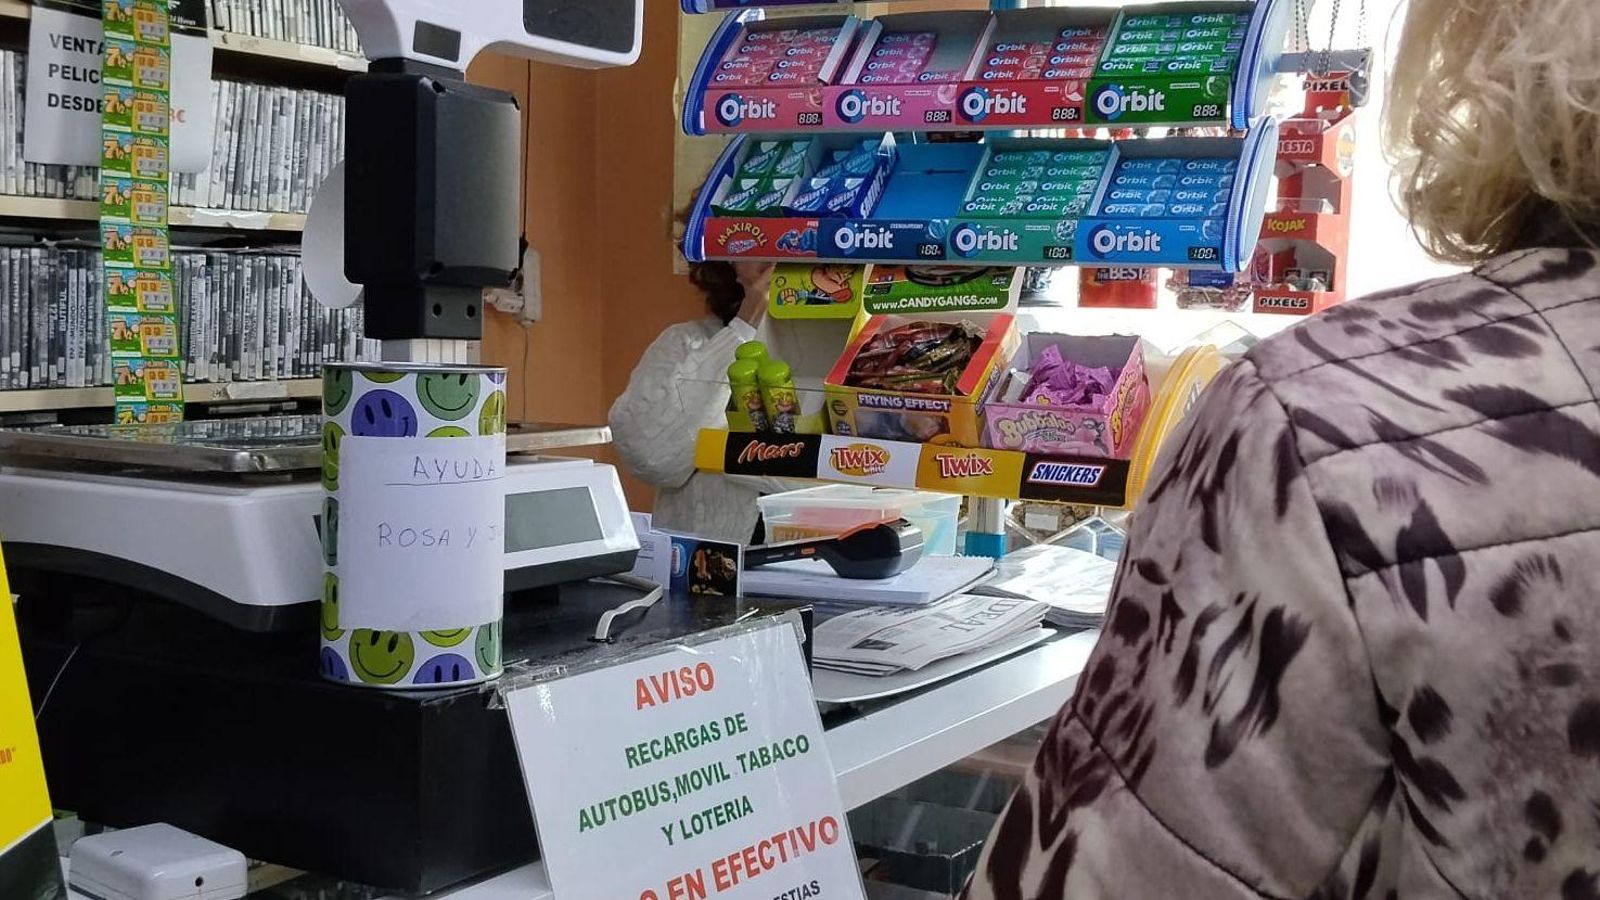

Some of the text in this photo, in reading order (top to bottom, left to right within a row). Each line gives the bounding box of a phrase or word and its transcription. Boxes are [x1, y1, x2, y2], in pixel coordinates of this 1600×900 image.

[1127, 18, 1158, 28] Orbit
[1192, 15, 1224, 24] Orbit
[1062, 28, 1092, 38] Orbit
[1121, 31, 1153, 41] Orbit
[1186, 28, 1219, 38] Orbit
[787, 47, 815, 56] Orbit
[996, 43, 1026, 52] Orbit
[1056, 42, 1087, 51] Orbit
[1115, 44, 1148, 53] Orbit
[1180, 43, 1214, 52] Orbit
[875, 48, 904, 56] Orbit
[723, 61, 750, 69] Orbit
[778, 60, 806, 68] Orbit
[868, 61, 896, 69] Orbit
[989, 56, 1020, 66] Orbit
[1050, 55, 1081, 65] Orbit
[1167, 60, 1202, 70] Orbit
[1102, 61, 1135, 70] Orbit
[48, 63, 103, 84] PELIC
[716, 73, 742, 81] Orbit
[770, 72, 798, 80] Orbit
[862, 74, 890, 82] Orbit
[920, 72, 948, 80] Orbit
[983, 70, 1014, 79] Orbit
[1045, 68, 1076, 78] Orbit
[1302, 80, 1349, 91] PIXEL
[841, 95, 901, 117] Orbit
[963, 91, 1027, 116] Orbit
[1097, 88, 1165, 115] Orbit
[721, 97, 776, 121] Orbit
[1278, 140, 1314, 153] IESTA
[1053, 153, 1084, 162] Orbit
[1122, 161, 1152, 169] Orbit
[1186, 161, 1218, 170] Orbit
[987, 168, 1017, 176] Orbit
[1047, 167, 1078, 176] Orbit
[1116, 176, 1148, 184] Orbit
[1181, 176, 1214, 185] Orbit
[981, 182, 1011, 191] Orbit
[1041, 182, 1073, 191] Orbit
[860, 165, 884, 220] SMINT
[1110, 190, 1142, 199] Orbit
[1176, 191, 1208, 199] Orbit
[723, 187, 759, 210] SMINT
[792, 187, 830, 209] SMINT
[966, 202, 996, 211] Orbit
[1027, 202, 1058, 211] Orbit
[1105, 204, 1137, 213] Orbit
[1171, 205, 1205, 214] Orbit
[1267, 218, 1306, 232] KOJAK
[718, 222, 768, 247] MAXIROLL
[835, 227, 894, 249] Orbit
[956, 229, 1018, 251] Orbit
[1094, 229, 1161, 253] Orbit
[1109, 267, 1143, 280] BEST
[1259, 297, 1307, 308] PIXELS
[858, 393, 950, 412] FRYING EFFECT
[996, 410, 1076, 449] Bubbaloo
[737, 439, 805, 464] Mars
[833, 445, 888, 470] Twix
[413, 456, 496, 481] AYUDA
[936, 453, 994, 478] Twix
[1032, 463, 1102, 484] SNICKERS
[377, 521, 450, 548] ROSA
[938, 599, 1020, 633] IDEAL
[635, 661, 716, 710] AVISO
[624, 712, 749, 769] RECARGAS DE
[735, 734, 810, 775] TABACO
[660, 795, 755, 846] Y LOTERIA
[666, 815, 839, 900] EN EFECTIVO
